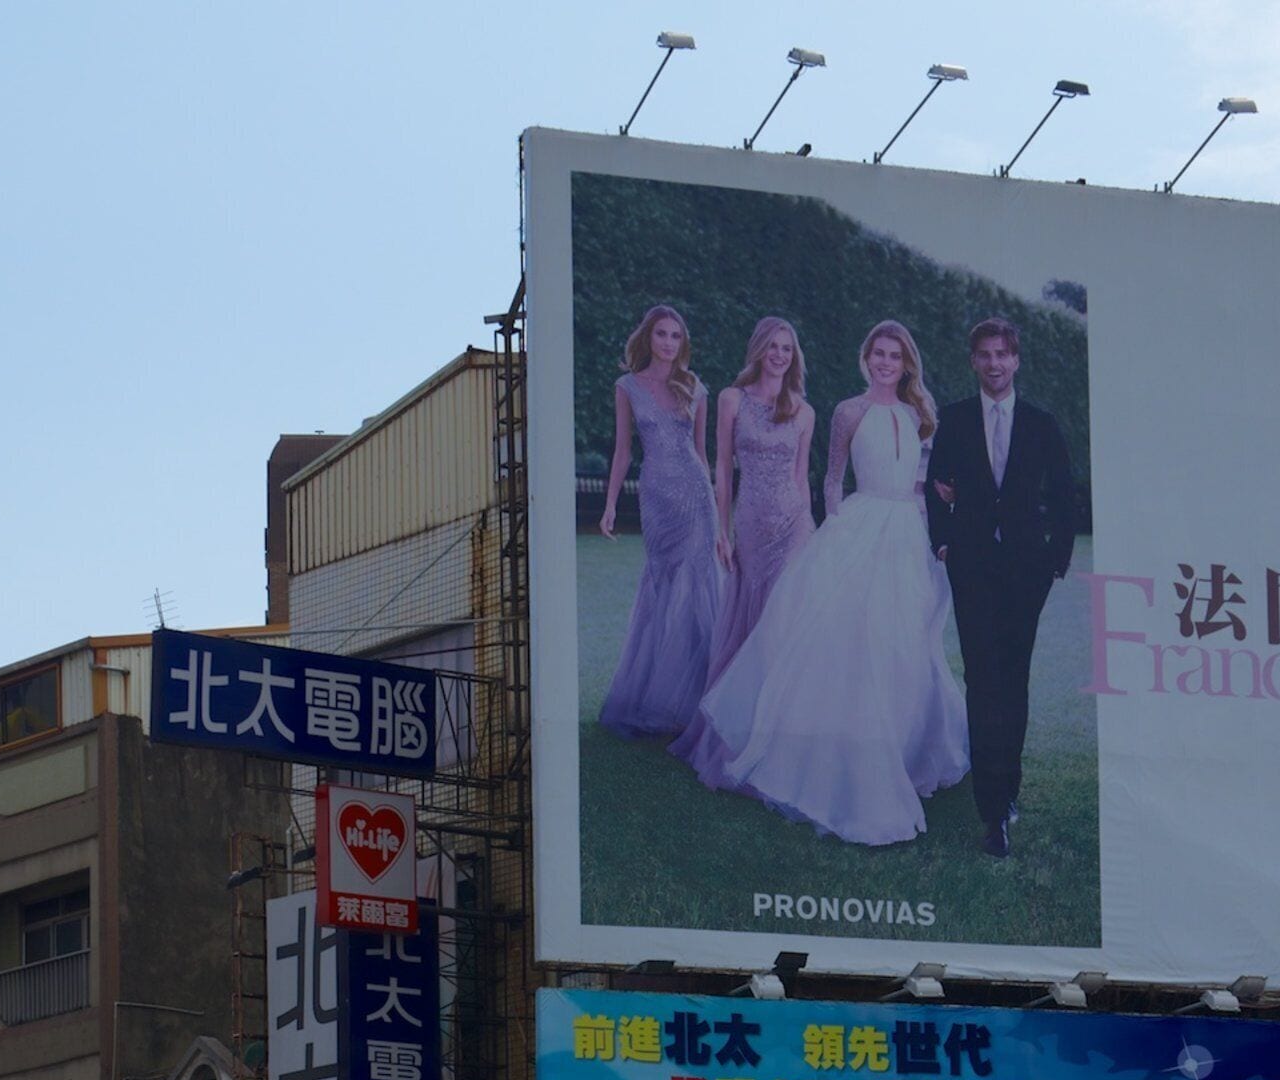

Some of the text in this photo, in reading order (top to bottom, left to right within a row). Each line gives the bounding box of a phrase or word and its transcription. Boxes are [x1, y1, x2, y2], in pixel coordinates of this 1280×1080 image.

[169, 649, 428, 759] 北太電腦
[336, 895, 409, 928] 萊爾富
[753, 893, 936, 927] PRONOVIAS
[573, 1011, 993, 1077] 前進北太 領先世代
